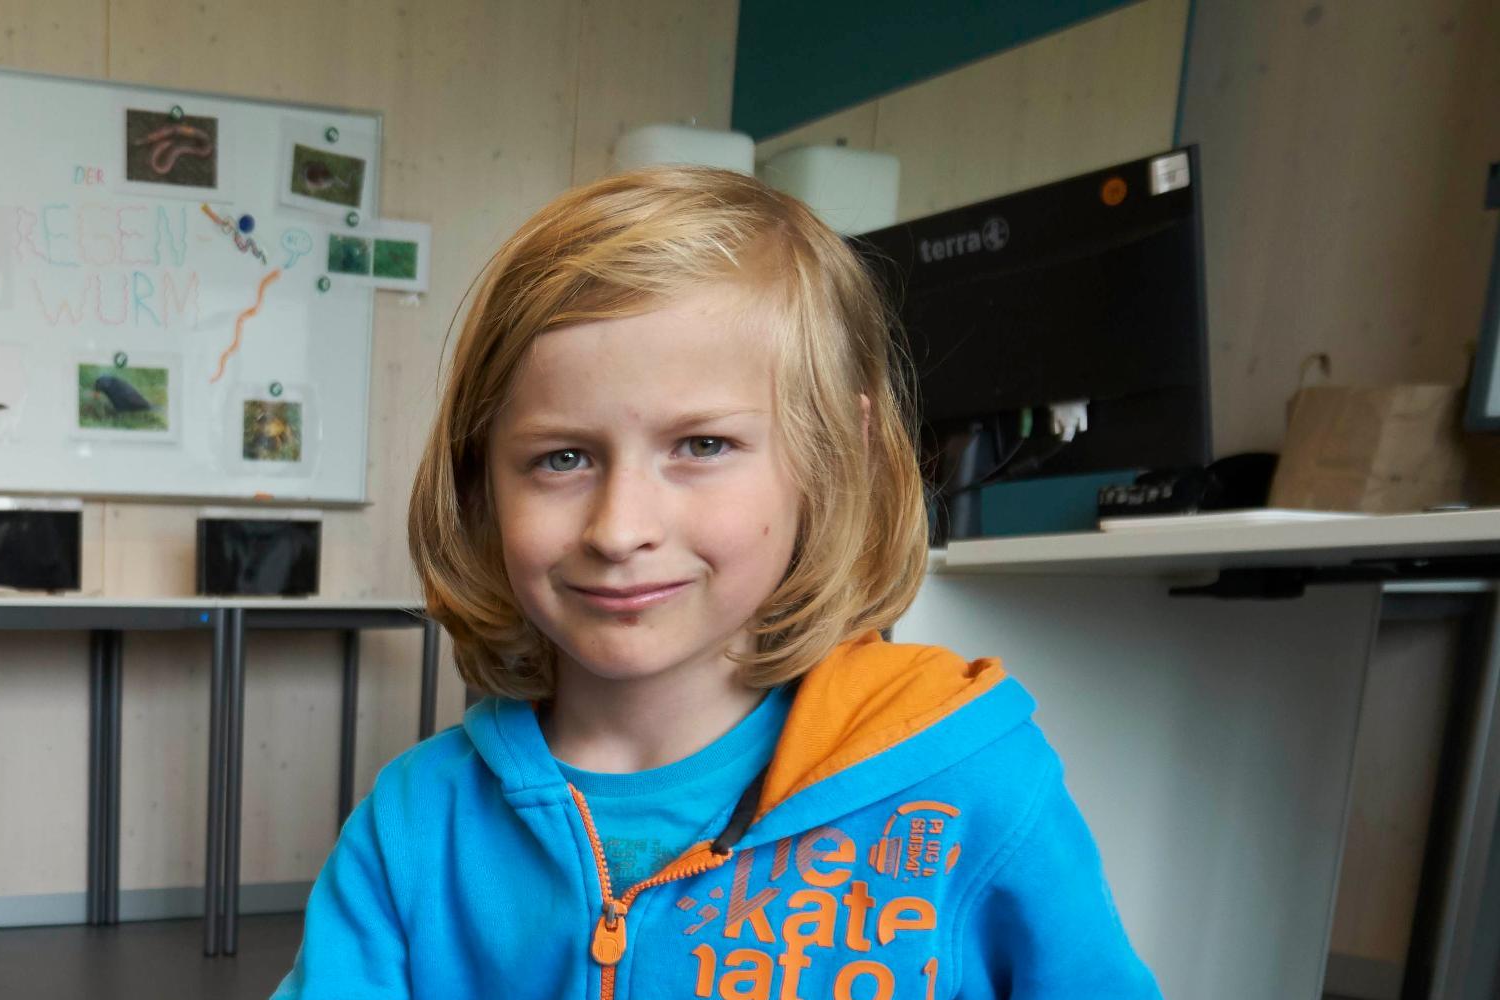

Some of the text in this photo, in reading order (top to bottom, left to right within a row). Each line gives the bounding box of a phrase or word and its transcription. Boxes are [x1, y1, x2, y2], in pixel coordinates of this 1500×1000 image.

[73, 164, 105, 185] DER
[921, 231, 981, 263] terra
[30, 270, 202, 331] WURM
